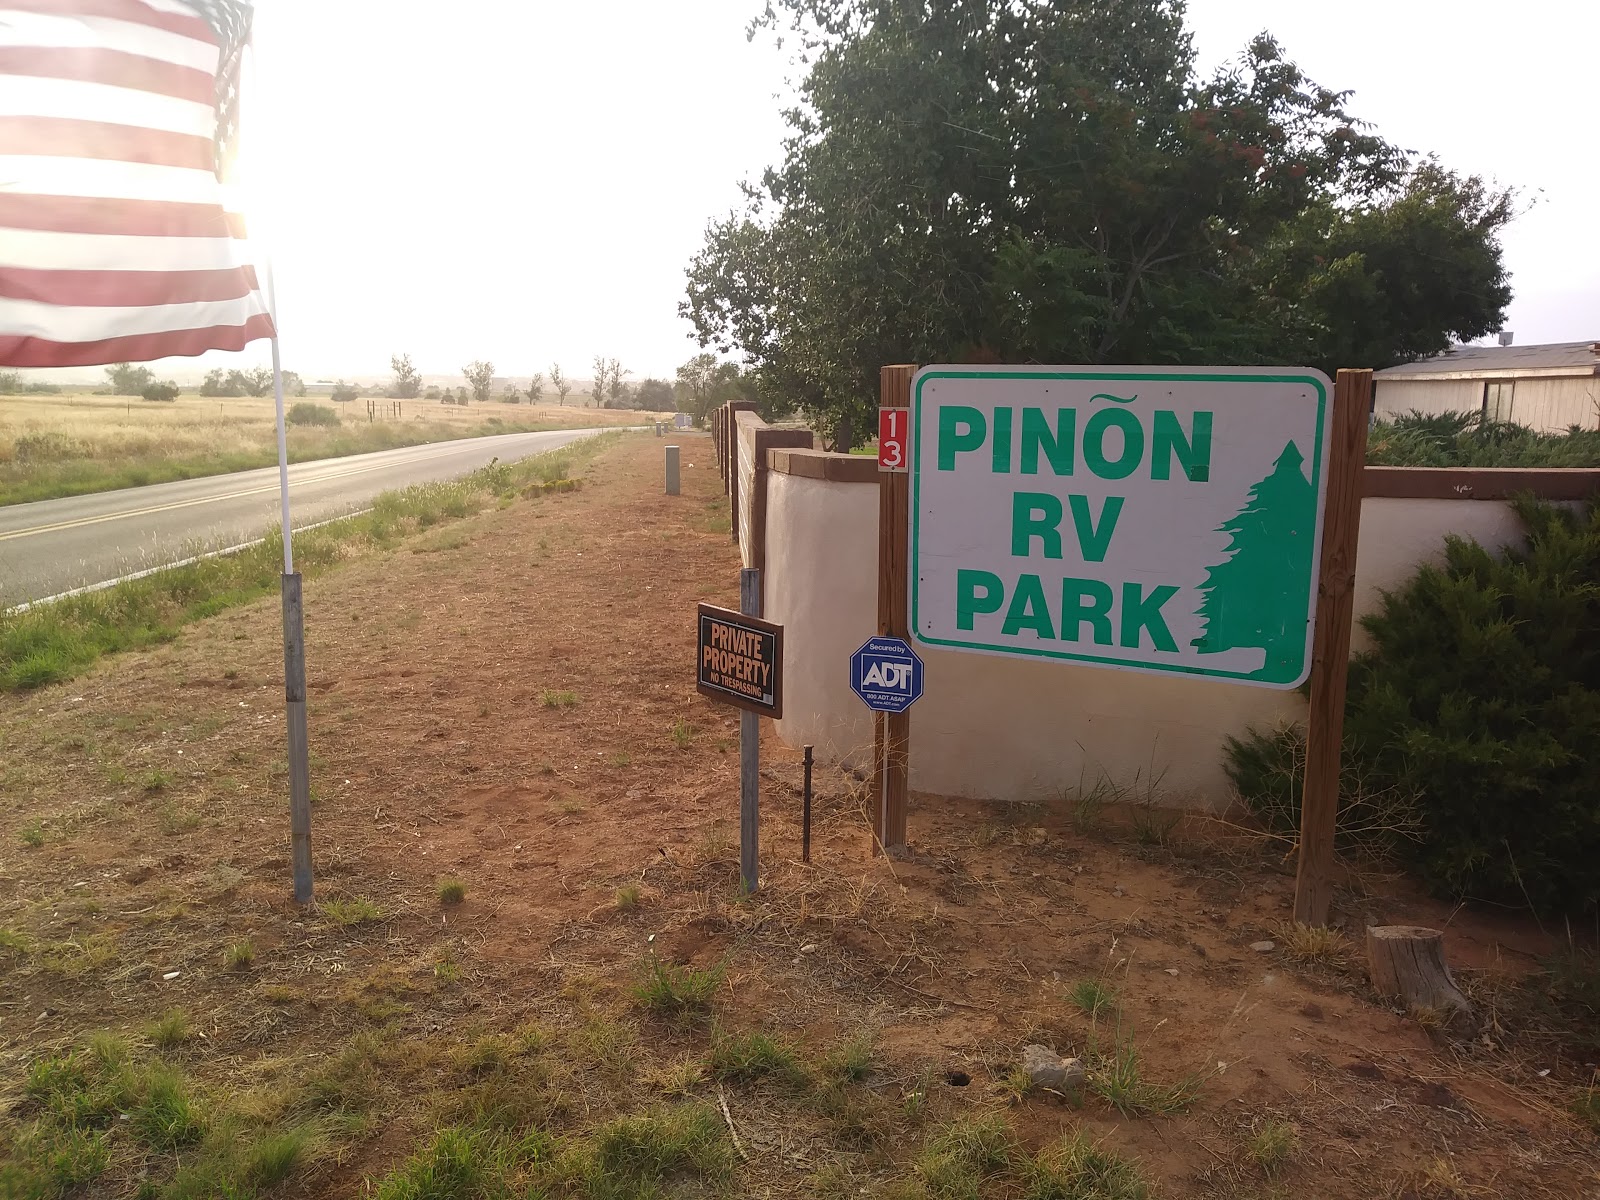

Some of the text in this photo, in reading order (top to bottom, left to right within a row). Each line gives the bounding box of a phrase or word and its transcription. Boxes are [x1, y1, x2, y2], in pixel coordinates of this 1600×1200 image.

[1012, 491, 1125, 563] RV
[957, 569, 1181, 653] PARK
[711, 623, 762, 660] PRIVATE
[870, 644, 906, 654] Secured by
[704, 645, 770, 687] PROPERTY
[711, 672, 762, 697] NO TRESPASSING
[863, 662, 912, 690] ADT
